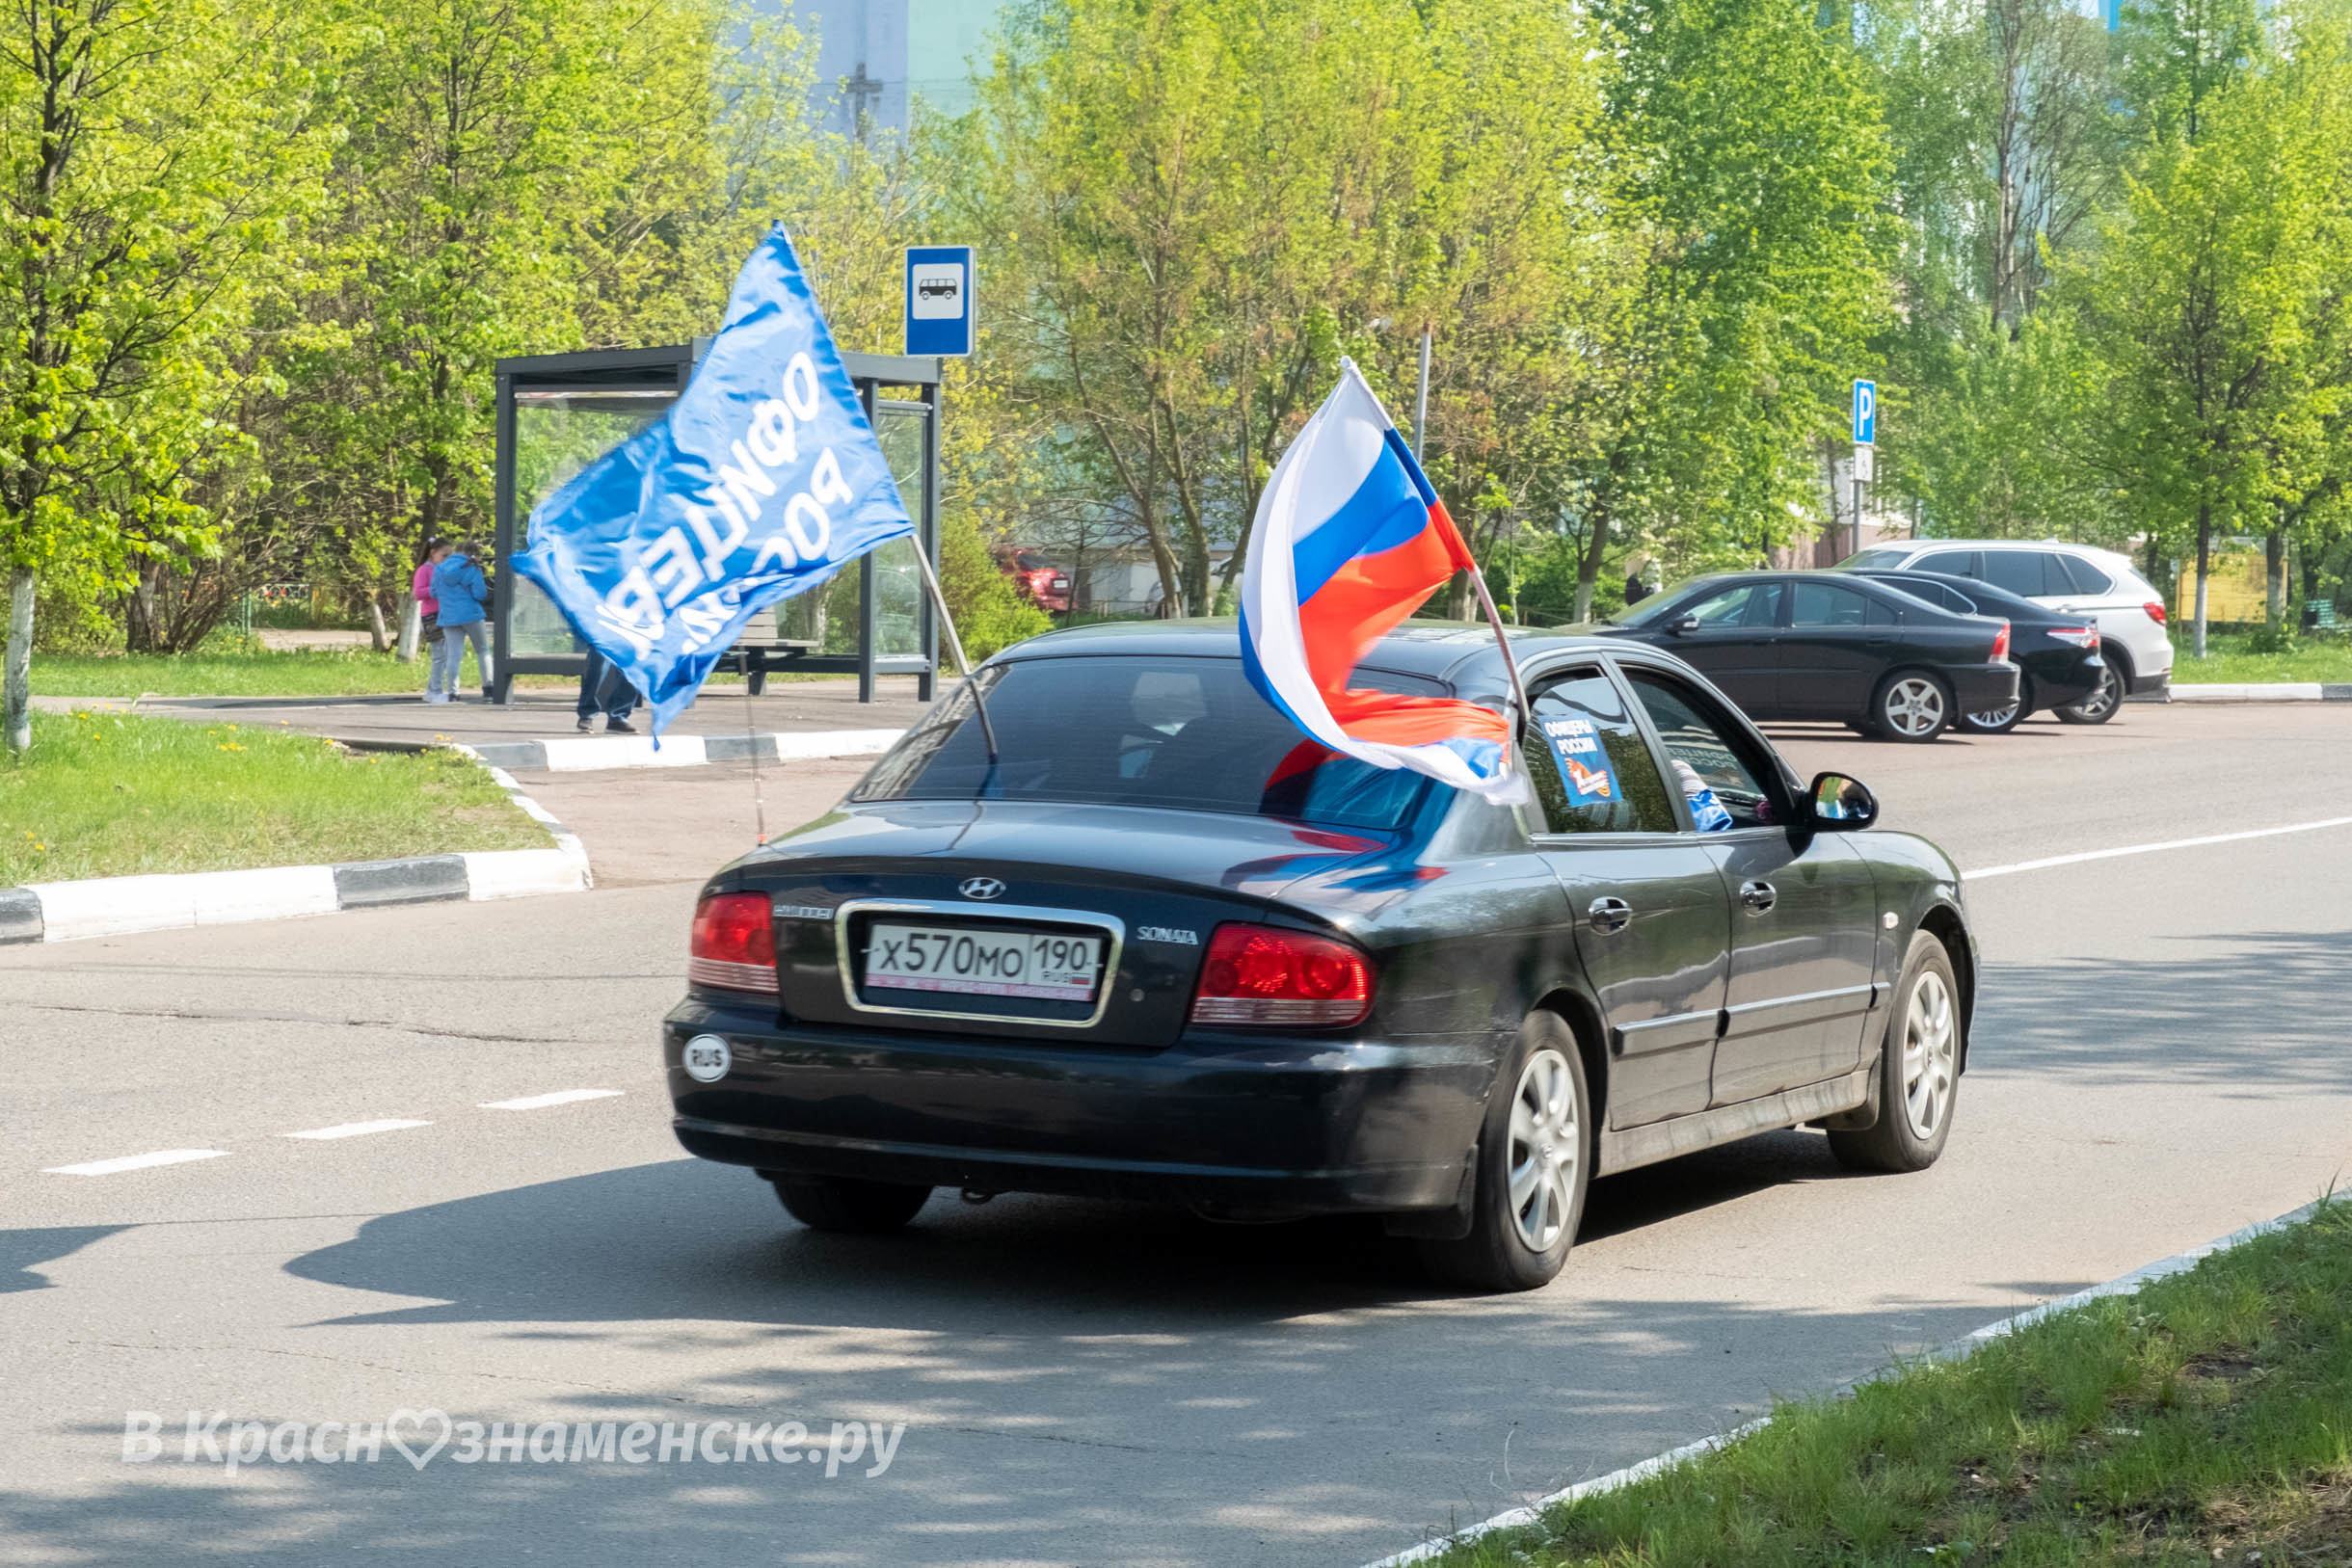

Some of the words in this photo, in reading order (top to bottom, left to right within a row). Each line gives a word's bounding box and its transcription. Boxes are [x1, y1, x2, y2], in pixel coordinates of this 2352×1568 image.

[1858, 387, 1872, 437] P
[1137, 926, 1198, 945] SONATA
[1033, 938, 1088, 971] 190
[1042, 970, 1072, 983] RUS
[691, 1049, 724, 1067] RUS
